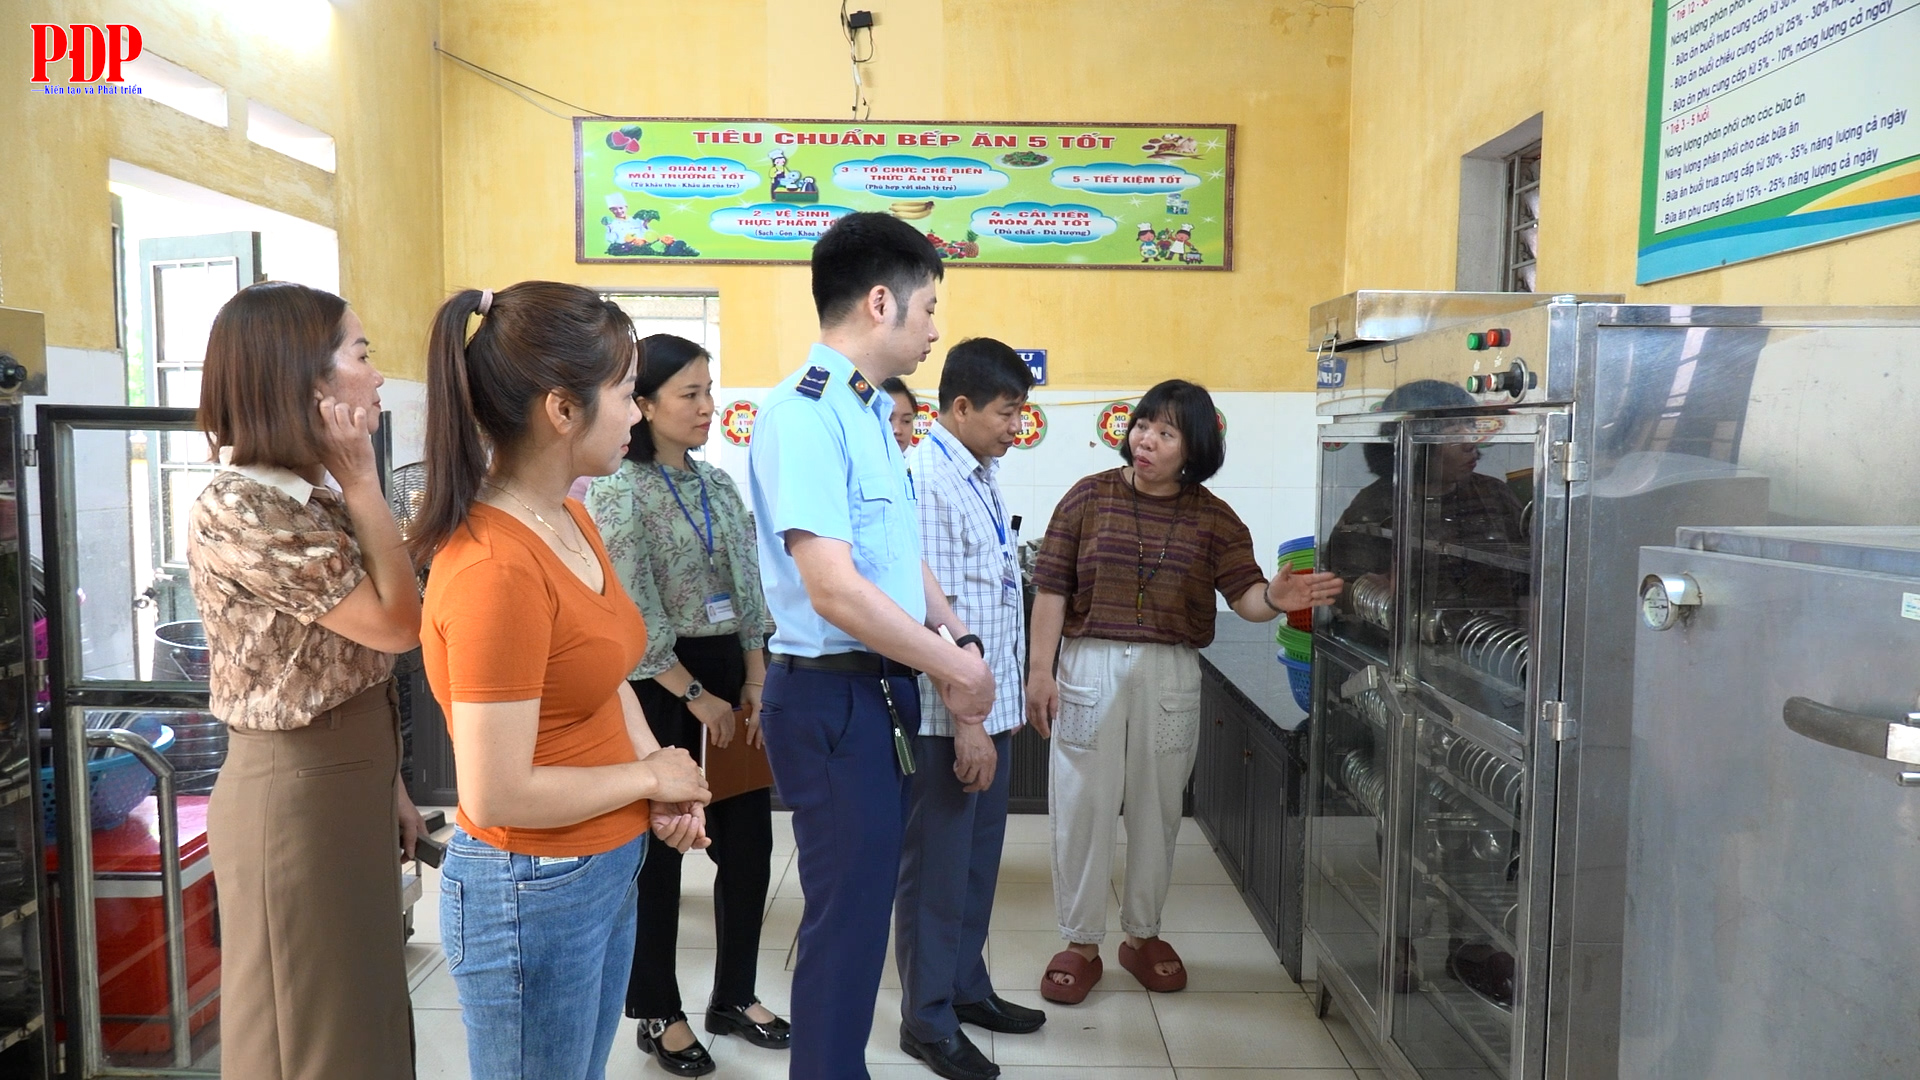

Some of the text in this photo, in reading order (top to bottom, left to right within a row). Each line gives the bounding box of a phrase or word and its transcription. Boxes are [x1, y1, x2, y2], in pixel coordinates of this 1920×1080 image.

[1732, 18, 1750, 36] cung
[1711, 77, 1730, 93] cung
[1778, 44, 1793, 62] 10%
[1795, 34, 1818, 53] năng
[1820, 21, 1847, 40] lượng
[1850, 7, 1863, 27] cả
[1737, 40, 1756, 57] cung
[1741, 114, 1755, 129] cho
[1757, 106, 1773, 121] các
[1775, 98, 1792, 114] bữa
[1794, 92, 1805, 105] ăn
[693, 129, 1116, 149] TIÊU CHUẨN BẾP ĂN 5 TỐT
[1740, 138, 1754, 153] cho
[1756, 132, 1770, 147] các
[1772, 125, 1786, 141] bữa
[1789, 121, 1799, 133] ăn
[1666, 187, 1678, 202] Bữa
[1680, 185, 1688, 198] ăn
[1689, 177, 1704, 194] buổi
[1721, 169, 1739, 184] cung
[1740, 161, 1755, 177] cấp
[1766, 152, 1783, 168] 30%
[1790, 143, 1808, 160] 35%
[1810, 135, 1833, 153] năng
[1835, 124, 1863, 143] lượng
[1865, 115, 1878, 133] cả
[1880, 108, 1908, 129] ngày
[628, 172, 656, 180] MÔI
[1093, 174, 1119, 183] TIẾT
[1123, 174, 1155, 185] KIỆM
[1159, 174, 1182, 184] TỐT
[1665, 209, 1677, 224] Bữa
[1679, 208, 1687, 220] ăn
[1702, 198, 1720, 213] cung
[1721, 192, 1735, 208] cấp
[1746, 184, 1762, 199] 15%
[1769, 176, 1786, 192] 25%
[1787, 171, 1809, 187] năng
[1812, 161, 1837, 179] lượng
[1840, 152, 1850, 169] cả
[1853, 147, 1879, 166] ngày
[797, 210, 830, 218] SINH
